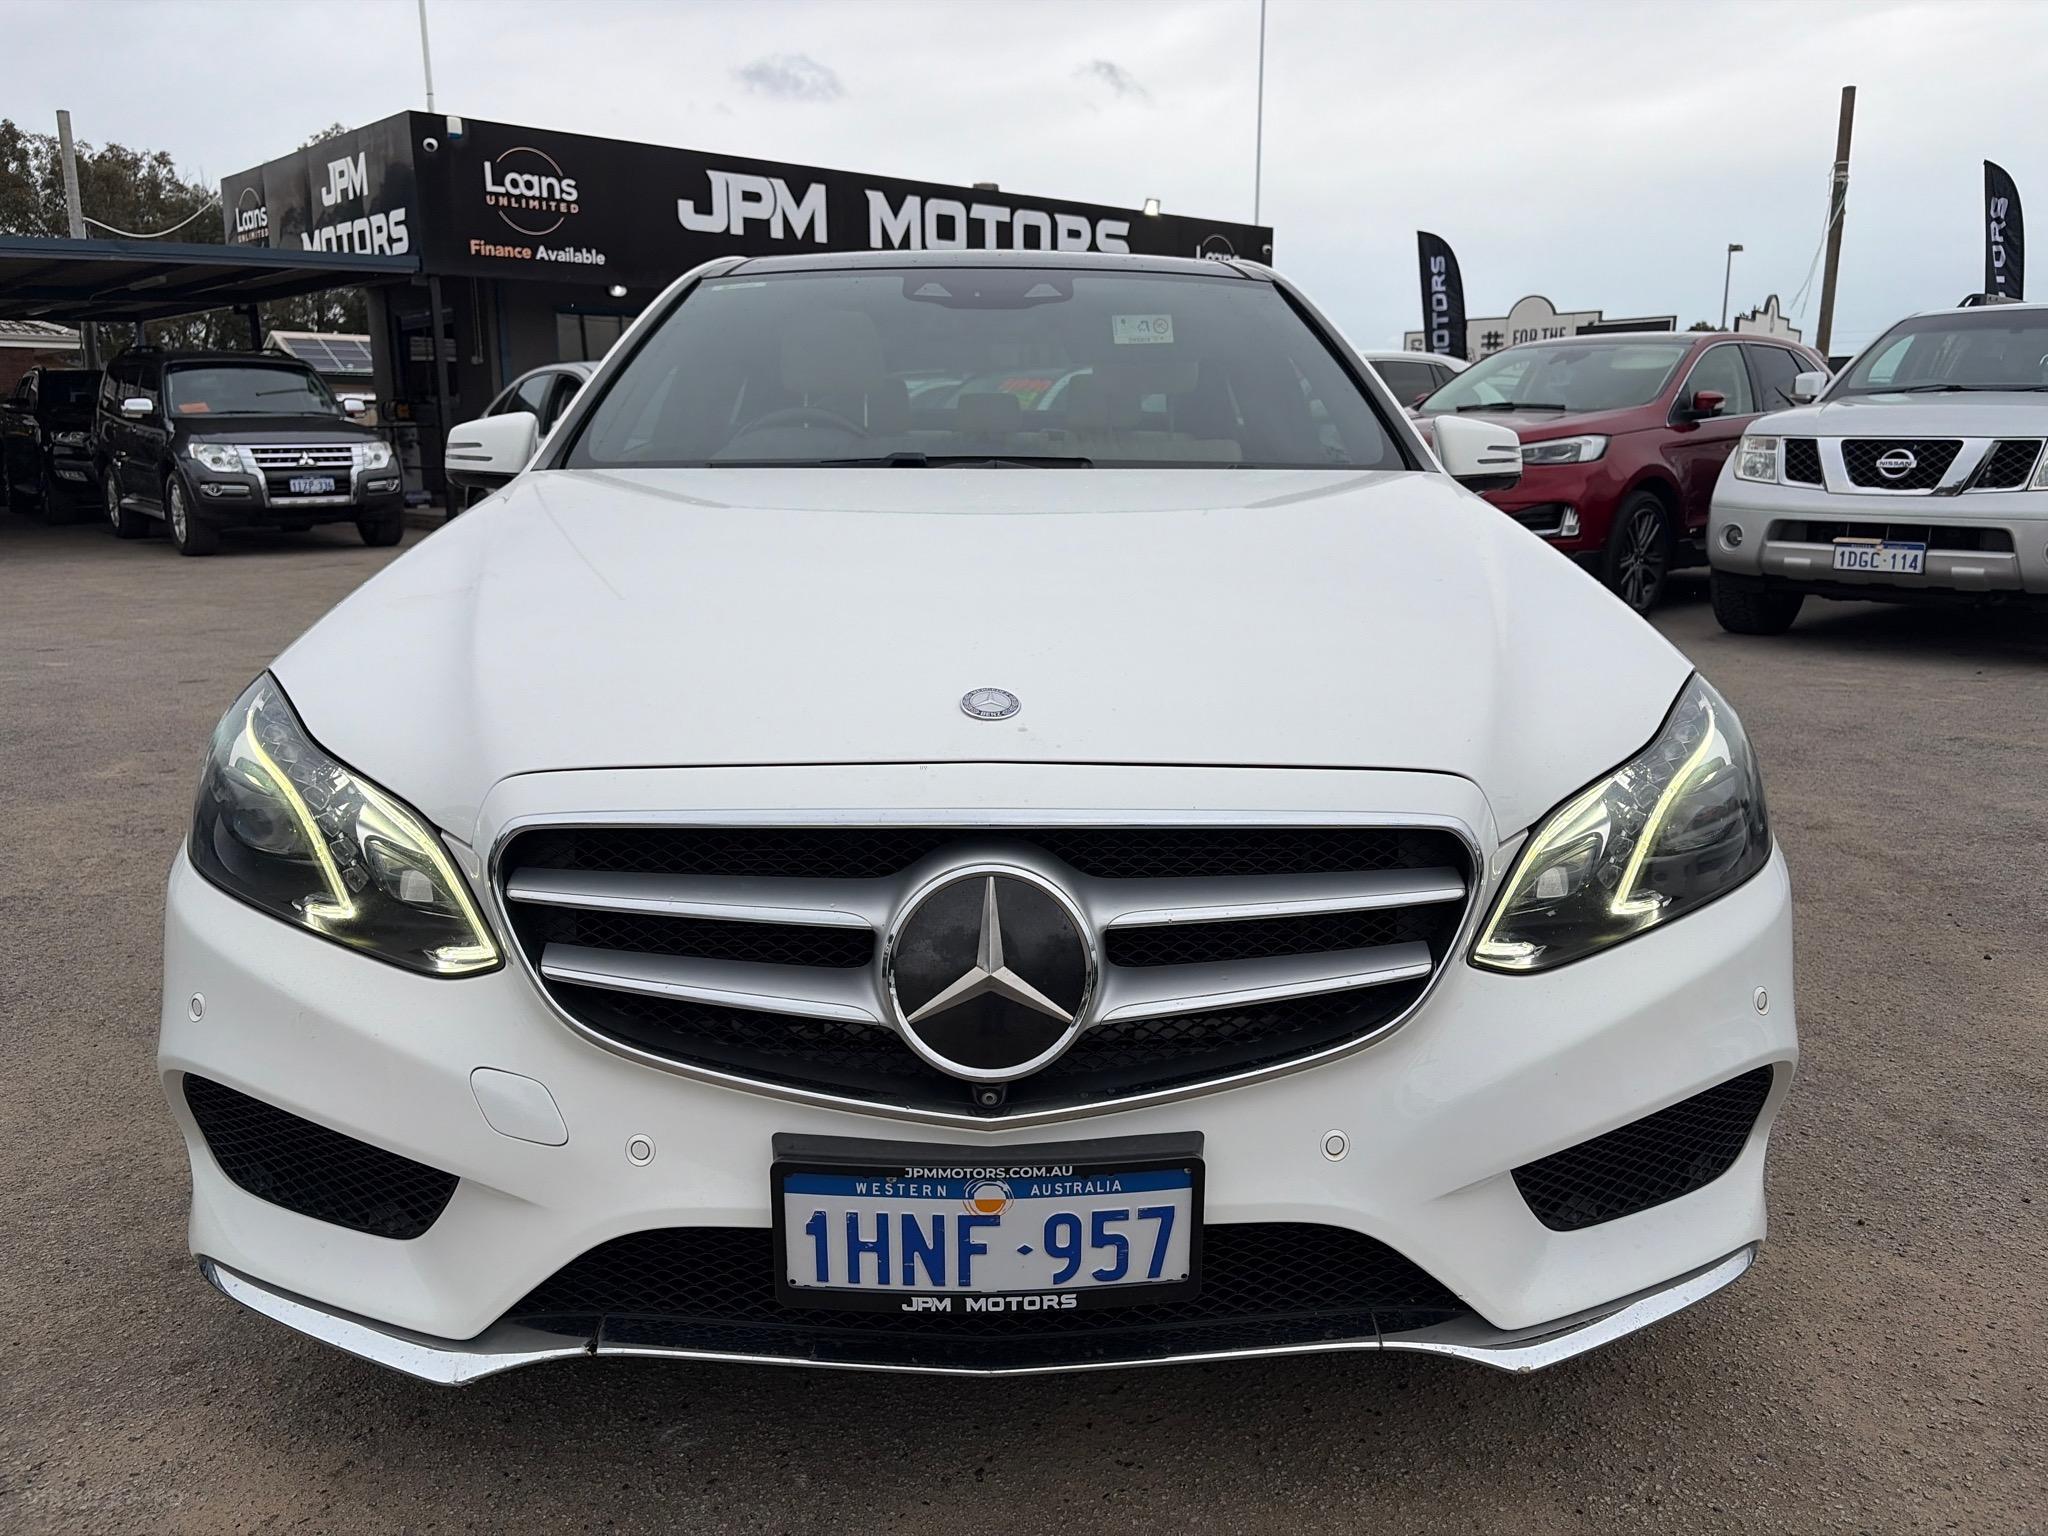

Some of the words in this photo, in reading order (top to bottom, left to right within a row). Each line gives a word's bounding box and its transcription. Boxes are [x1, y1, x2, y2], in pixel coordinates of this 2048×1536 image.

[321, 152, 369, 208] JPM
[484, 161, 579, 202] Loans
[486, 195, 579, 214] UNLIMITED
[677, 169, 827, 244] JPM
[864, 189, 1130, 254] MOTORS
[235, 206, 268, 233] Loans
[301, 207, 410, 256] MOTORS
[470, 239, 533, 259] Finance
[535, 245, 606, 266] Available
[1430, 255, 1450, 354] OTORS
[904, 1165, 1074, 1180] JPMMOTORS.COM.AU
[855, 1181, 948, 1198] WESTERN
[1030, 1180, 1123, 1196] AUSTRALIA
[902, 1296, 952, 1312] JPM
[966, 1294, 1077, 1312] MOTORS
